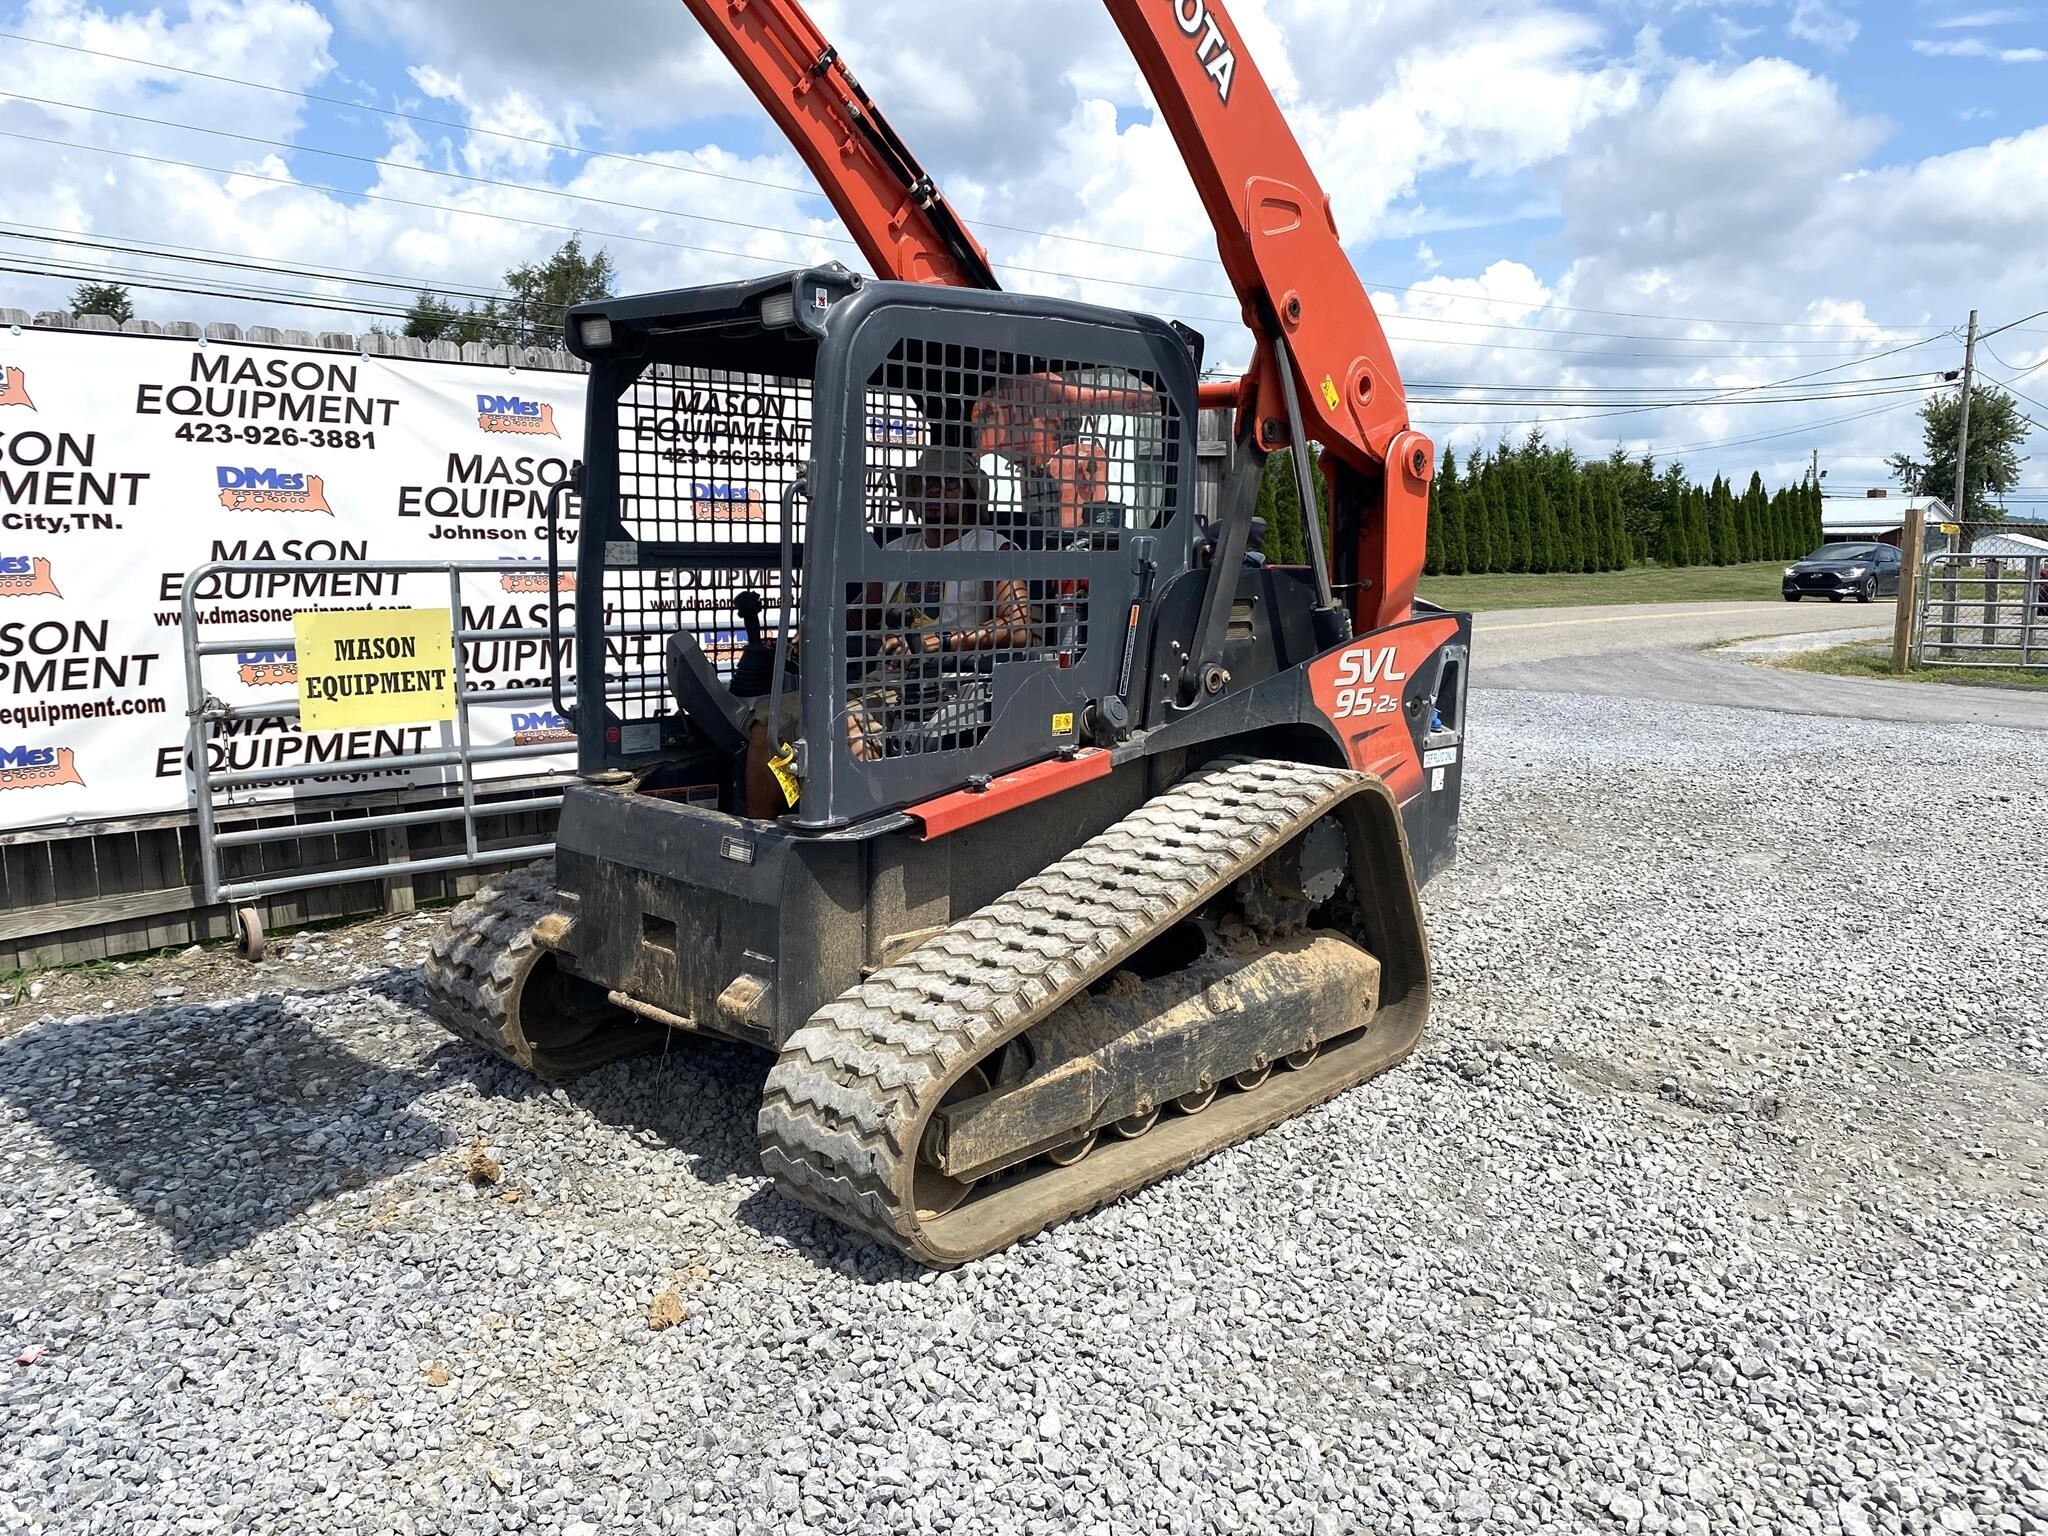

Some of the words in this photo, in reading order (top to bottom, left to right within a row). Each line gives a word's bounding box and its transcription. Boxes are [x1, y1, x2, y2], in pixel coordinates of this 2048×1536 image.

[190, 352, 358, 393] MASON
[136, 383, 400, 426] EQUIPMENT
[0, 430, 95, 467] ON
[175, 422, 376, 450] 423-926-3881
[446, 452, 583, 487] MASO
[398, 486, 581, 520] EQUIPME
[2, 512, 123, 534] City,TN.
[428, 524, 527, 541] Johnson
[534, 526, 578, 544] Cty
[210, 539, 369, 561] MASON
[160, 571, 408, 601] EQUIPMENT
[334, 636, 416, 662] MASON
[1333, 646, 1407, 688] SVL
[306, 669, 447, 702] EQUIPMENT
